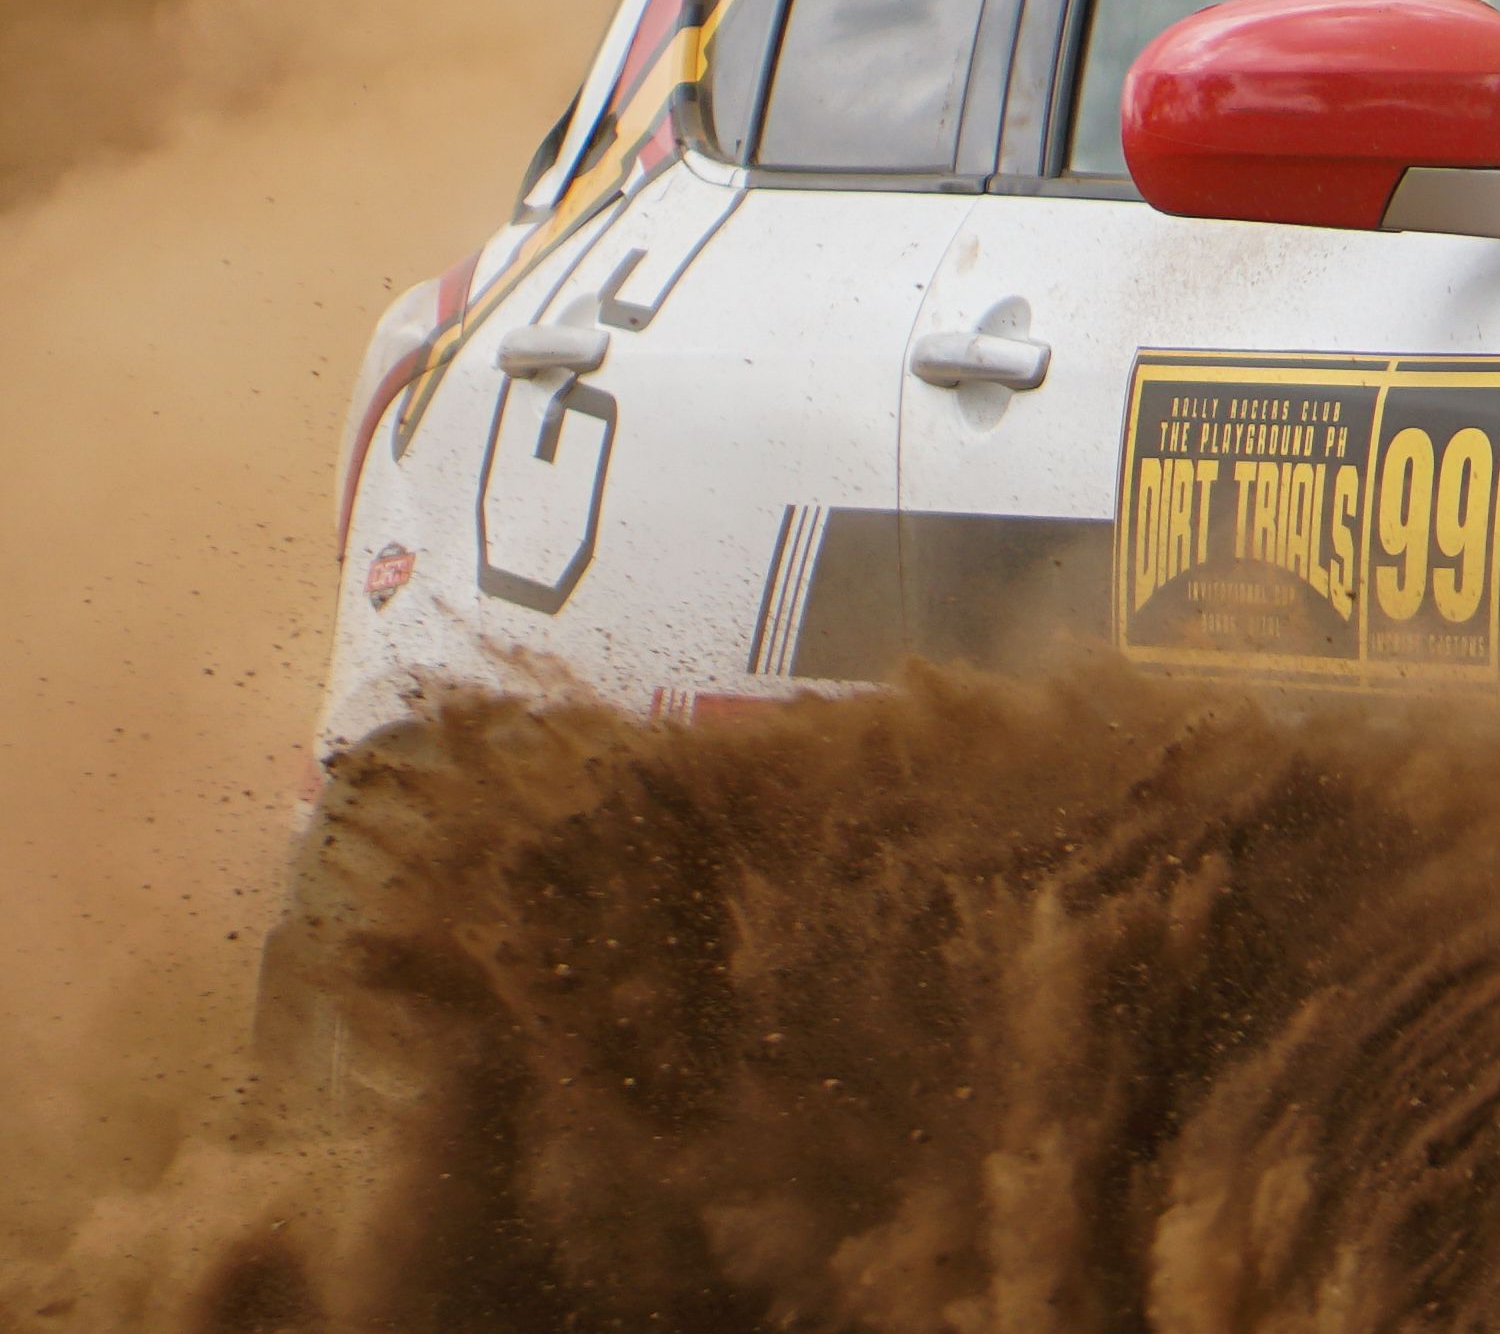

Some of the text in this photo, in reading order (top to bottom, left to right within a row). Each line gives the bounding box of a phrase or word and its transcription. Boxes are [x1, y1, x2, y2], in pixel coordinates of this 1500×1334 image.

[1160, 421, 1349, 459] THE PLAYGROUND PH
[1172, 397, 1342, 422] RALLY RACERS CLUB
[1135, 458, 1360, 622] DIRT TRIALS
[1376, 427, 1493, 622] 99
